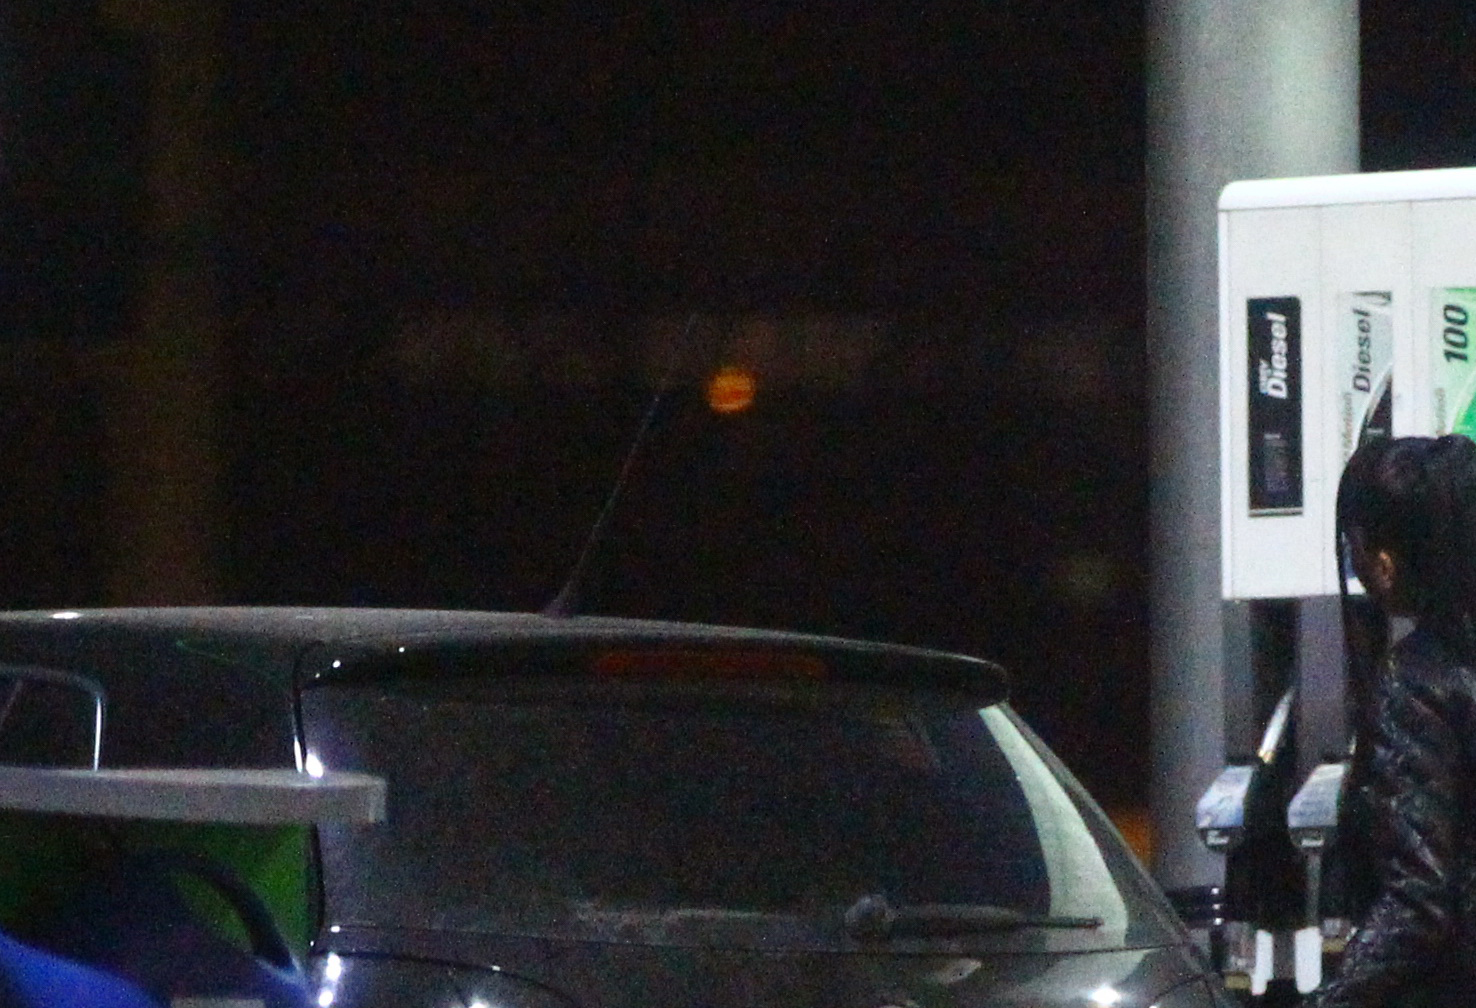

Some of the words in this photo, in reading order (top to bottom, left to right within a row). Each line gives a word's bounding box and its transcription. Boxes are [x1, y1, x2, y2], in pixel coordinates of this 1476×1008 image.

[1266, 312, 1288, 400] Diesel
[1353, 307, 1372, 393] Diesel
[1443, 304, 1469, 363] 100
